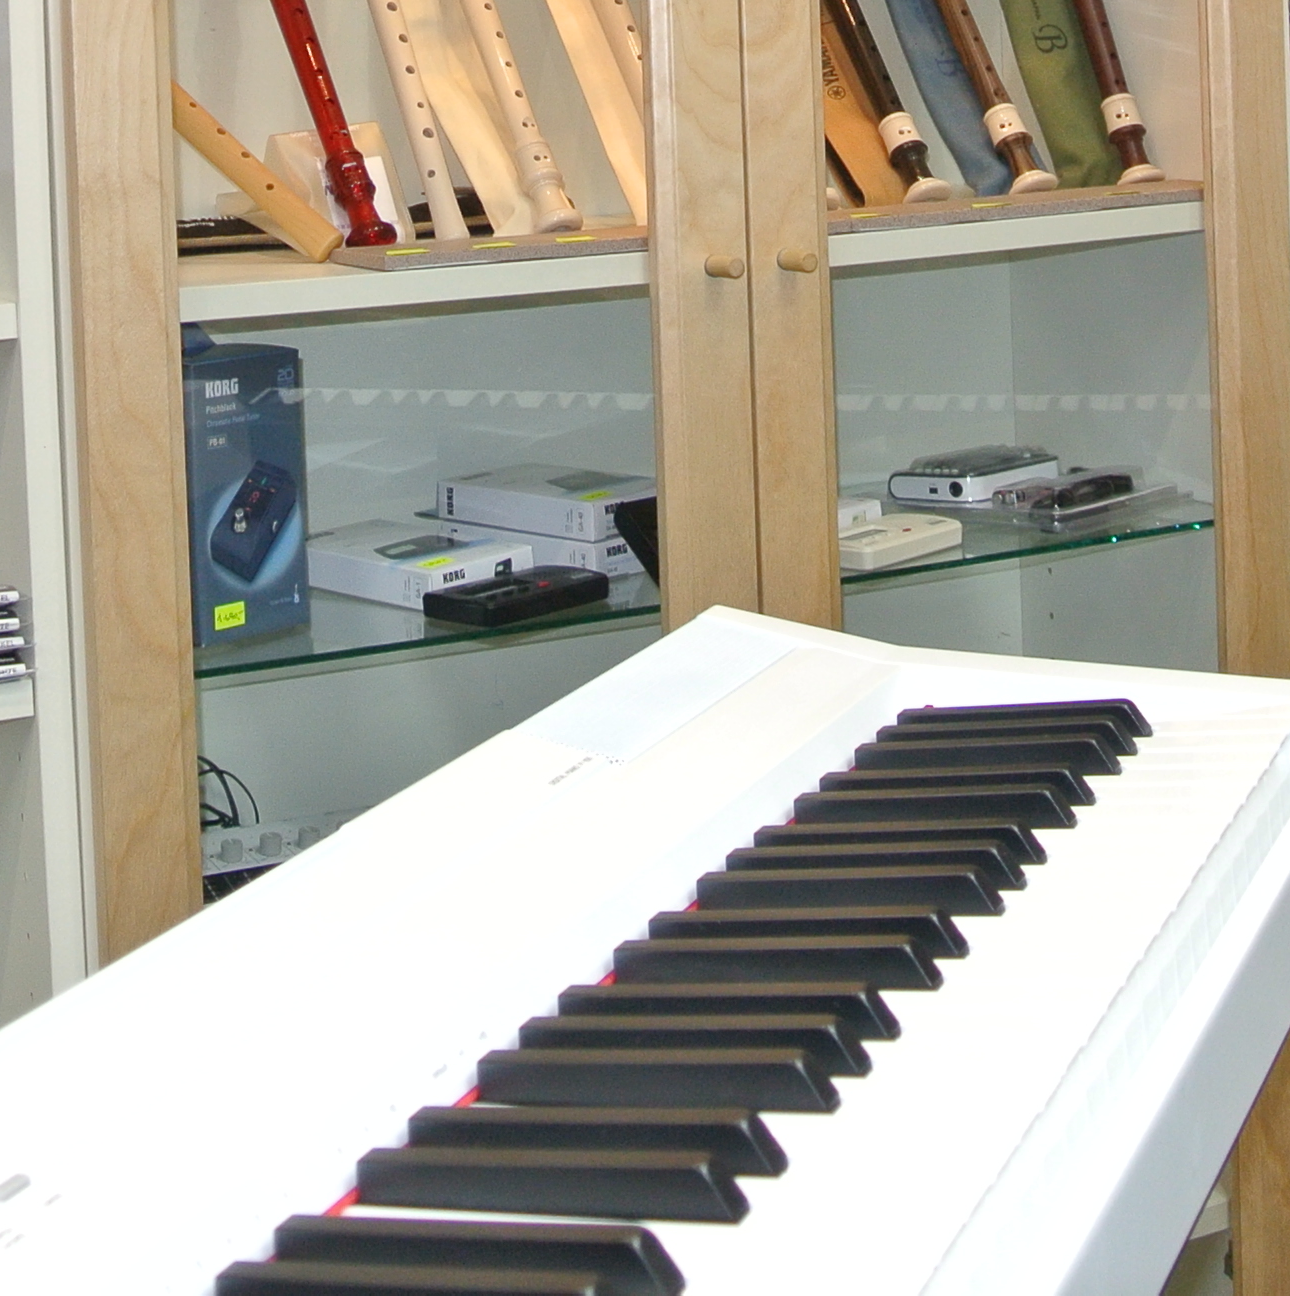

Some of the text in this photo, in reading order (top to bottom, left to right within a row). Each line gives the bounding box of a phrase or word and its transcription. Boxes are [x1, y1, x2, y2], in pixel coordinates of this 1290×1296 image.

[204, 377, 240, 400] KORG
[445, 486, 455, 517] KORG
[605, 542, 629, 559] KORG
[442, 567, 467, 585] KORG
